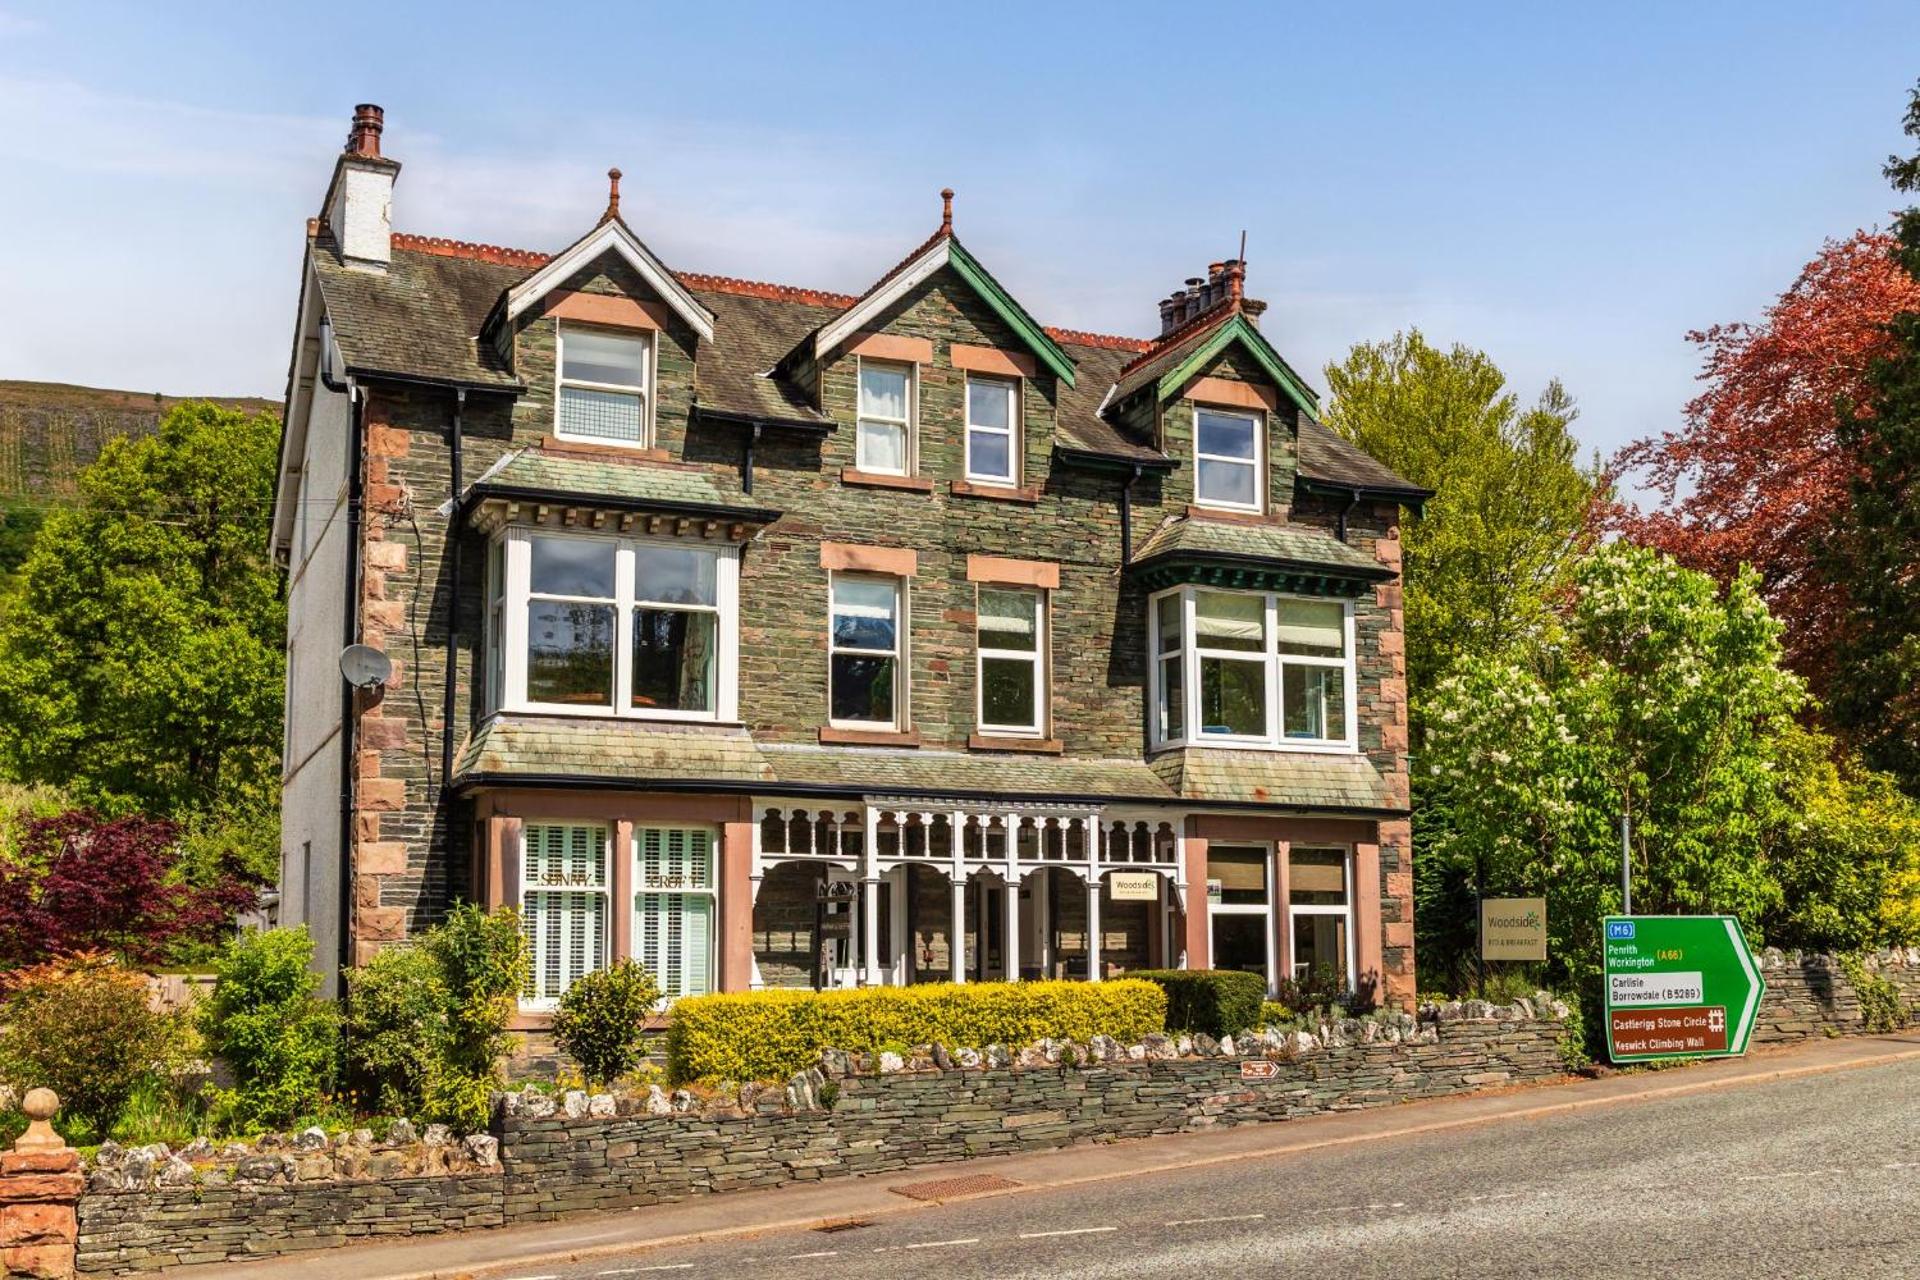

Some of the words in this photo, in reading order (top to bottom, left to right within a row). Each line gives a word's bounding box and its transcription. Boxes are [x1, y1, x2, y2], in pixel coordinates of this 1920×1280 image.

[1488, 915, 1535, 928] Woodside
[1609, 924, 1634, 937] (M6)
[1608, 945, 1638, 955] Penrith
[1656, 949, 1683, 961] (A66)
[1608, 957, 1654, 969] Workington
[1612, 977, 1644, 988] Carlisle
[1613, 989, 1660, 1001] Borrowdale
[1662, 988, 1701, 1000] (B5289)
[1613, 1018, 1655, 1031] Castlerigg
[1657, 1017, 1682, 1028] Stone
[1684, 1016, 1707, 1027] Circle
[1615, 1040, 1647, 1051] Keswick
[1649, 1038, 1684, 1050] Climbing
[1686, 1037, 1705, 1048] Wall
